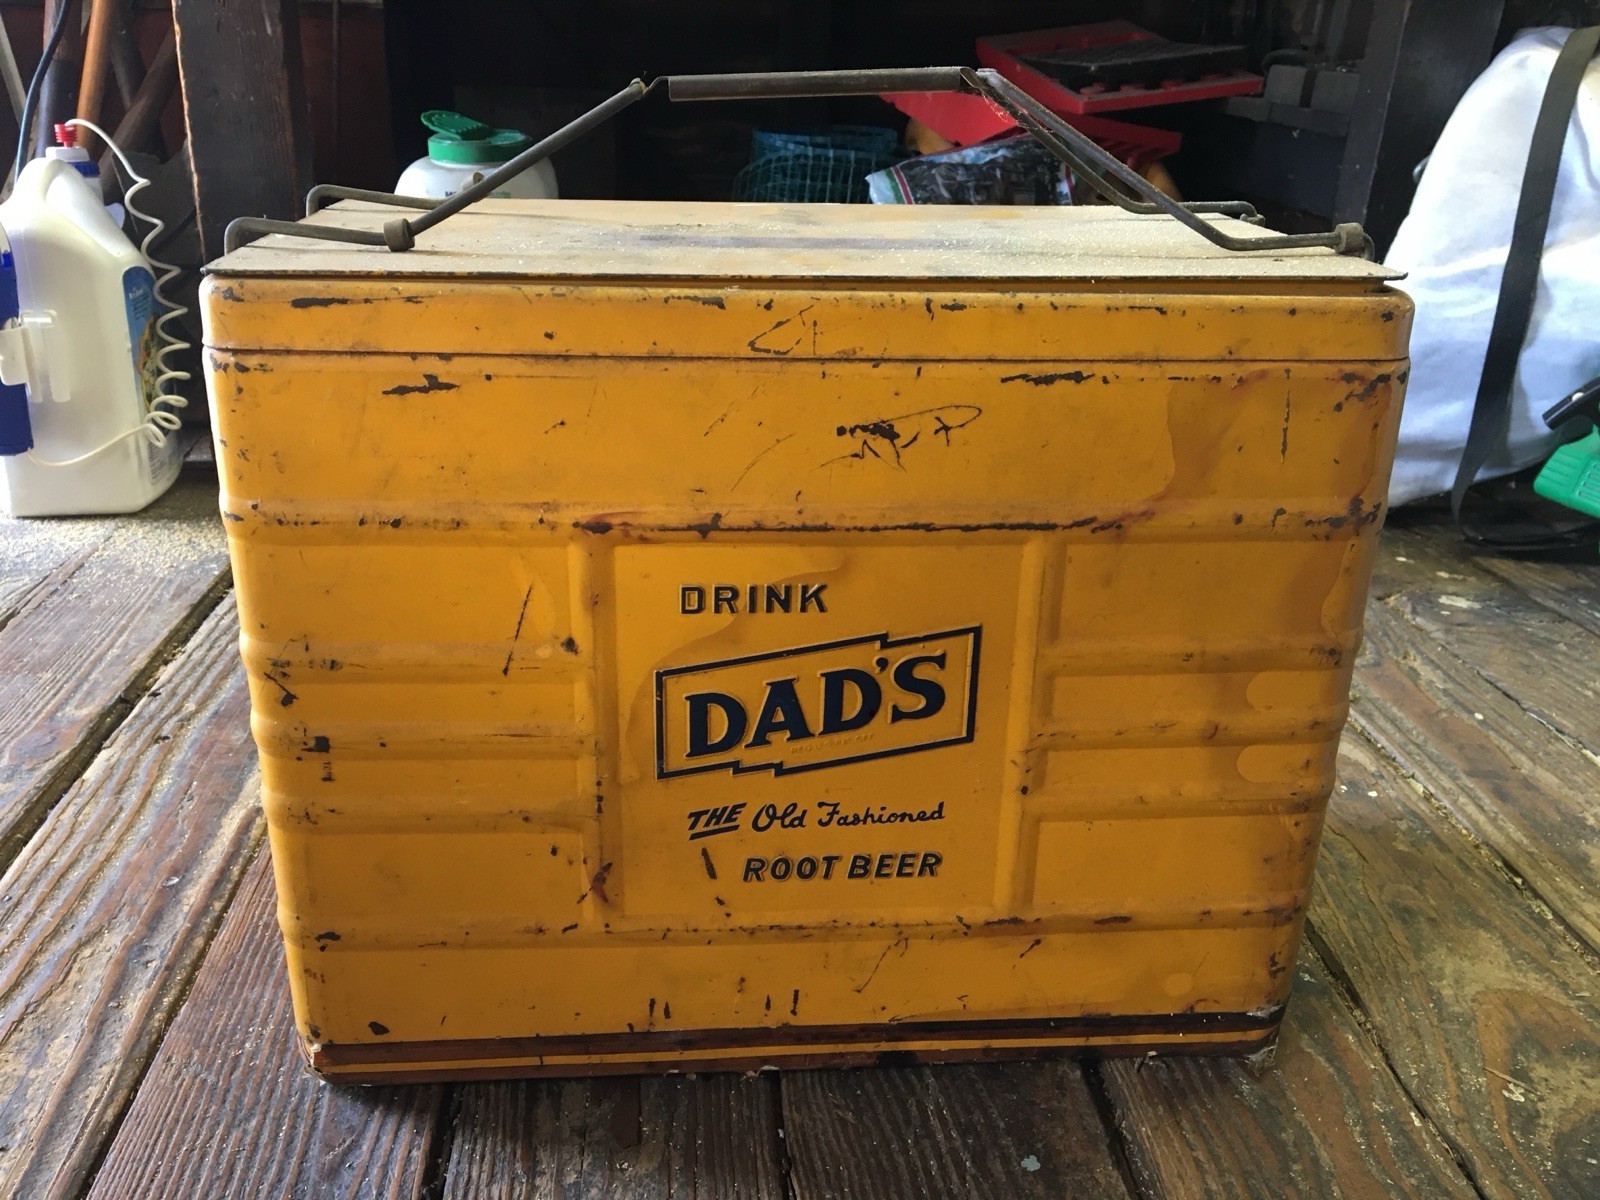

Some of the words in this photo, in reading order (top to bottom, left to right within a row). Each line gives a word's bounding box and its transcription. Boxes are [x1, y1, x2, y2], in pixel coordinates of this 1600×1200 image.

[680, 583, 828, 615] DRINK
[683, 649, 948, 759] DAD'S
[686, 802, 748, 834] THE
[751, 802, 808, 833] Old
[816, 800, 946, 828] Fashioned
[742, 854, 842, 883] ROOT
[846, 851, 943, 881] BEER
